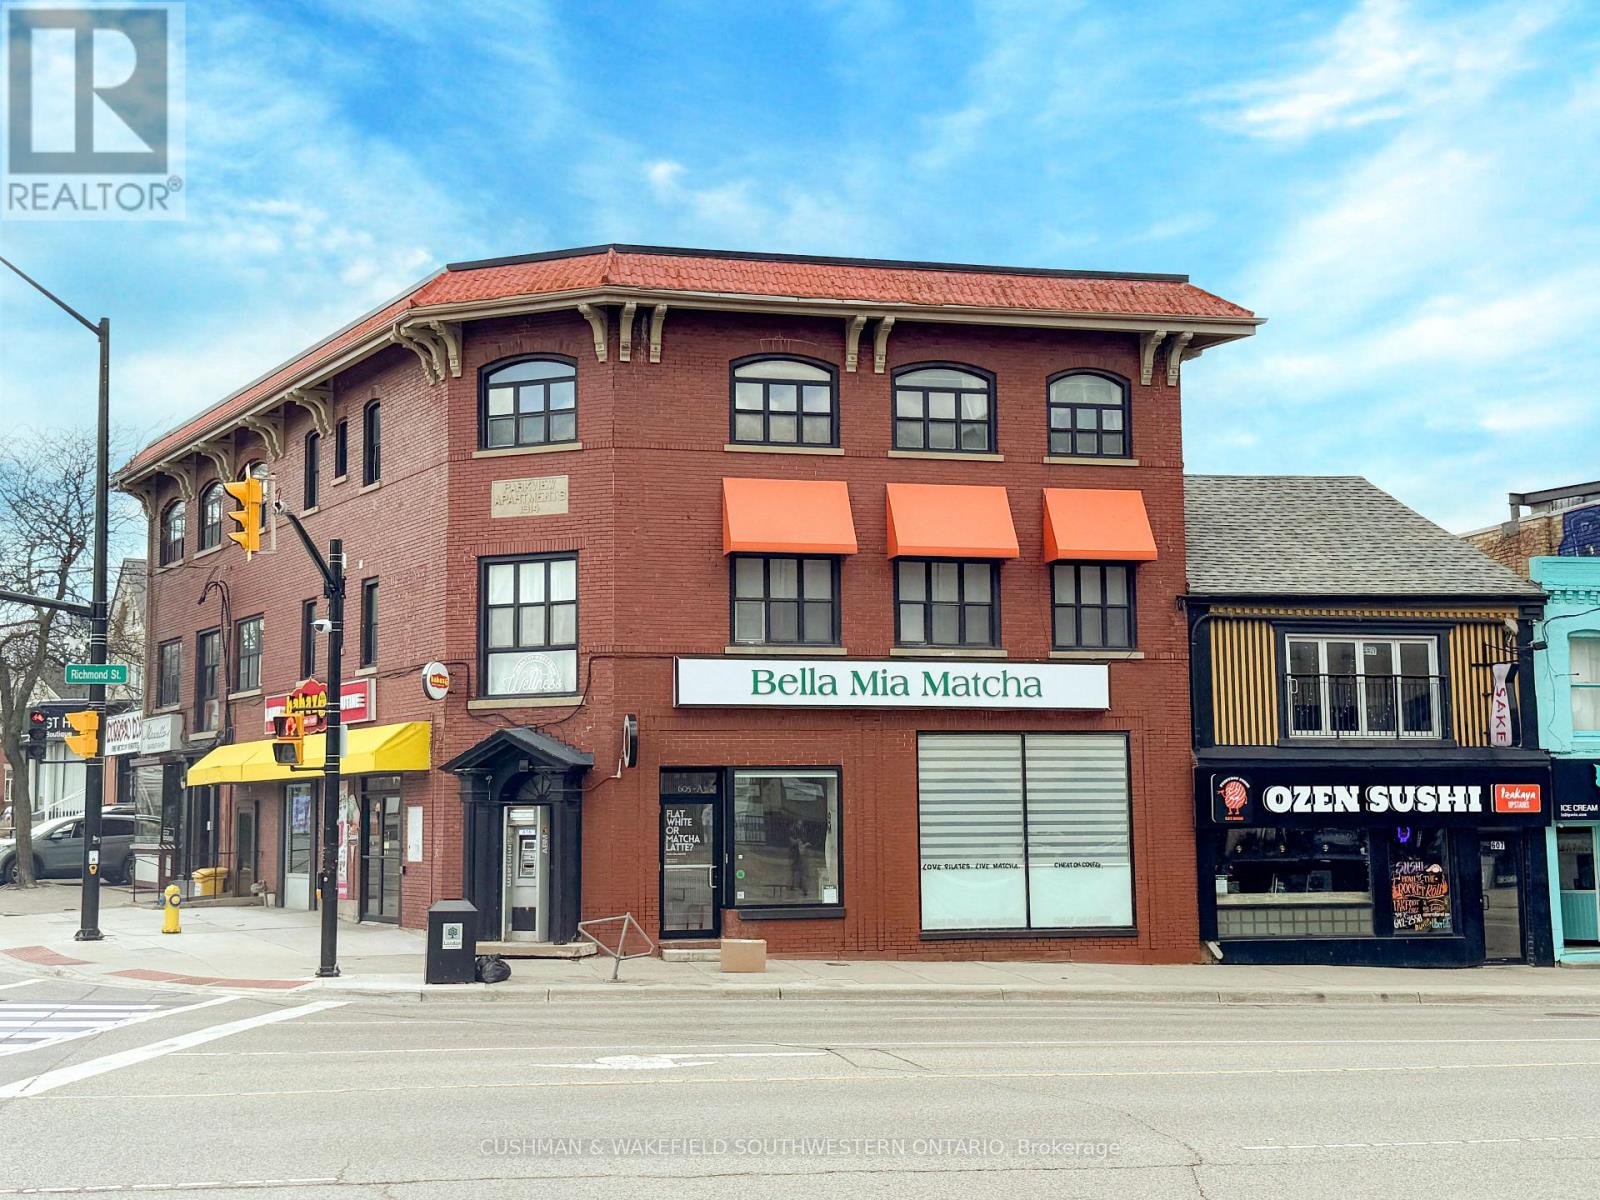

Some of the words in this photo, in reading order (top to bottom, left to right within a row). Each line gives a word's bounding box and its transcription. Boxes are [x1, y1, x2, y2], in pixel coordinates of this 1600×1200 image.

[71, 669, 108, 680] Richmond
[111, 668, 121, 680] St.
[751, 668, 838, 696] Bella
[850, 669, 910, 696] Mia
[921, 670, 1042, 697] Matcha
[1496, 687, 1507, 743] SAKE
[1501, 787, 1536, 800] Izakaya
[1263, 785, 1361, 813] OZEN
[1365, 785, 1483, 813] SUSHI
[1560, 804, 1573, 812] ICE
[1573, 804, 1599, 812] CREAM
[666, 810, 686, 818] FLAT
[667, 818, 693, 827] WHITE
[666, 827, 680, 835] OR
[666, 835, 700, 843] MATCHA
[666, 843, 694, 852] LATTE?
[1490, 841, 1505, 850] 607
[1395, 861, 1424, 874] SUSHI
